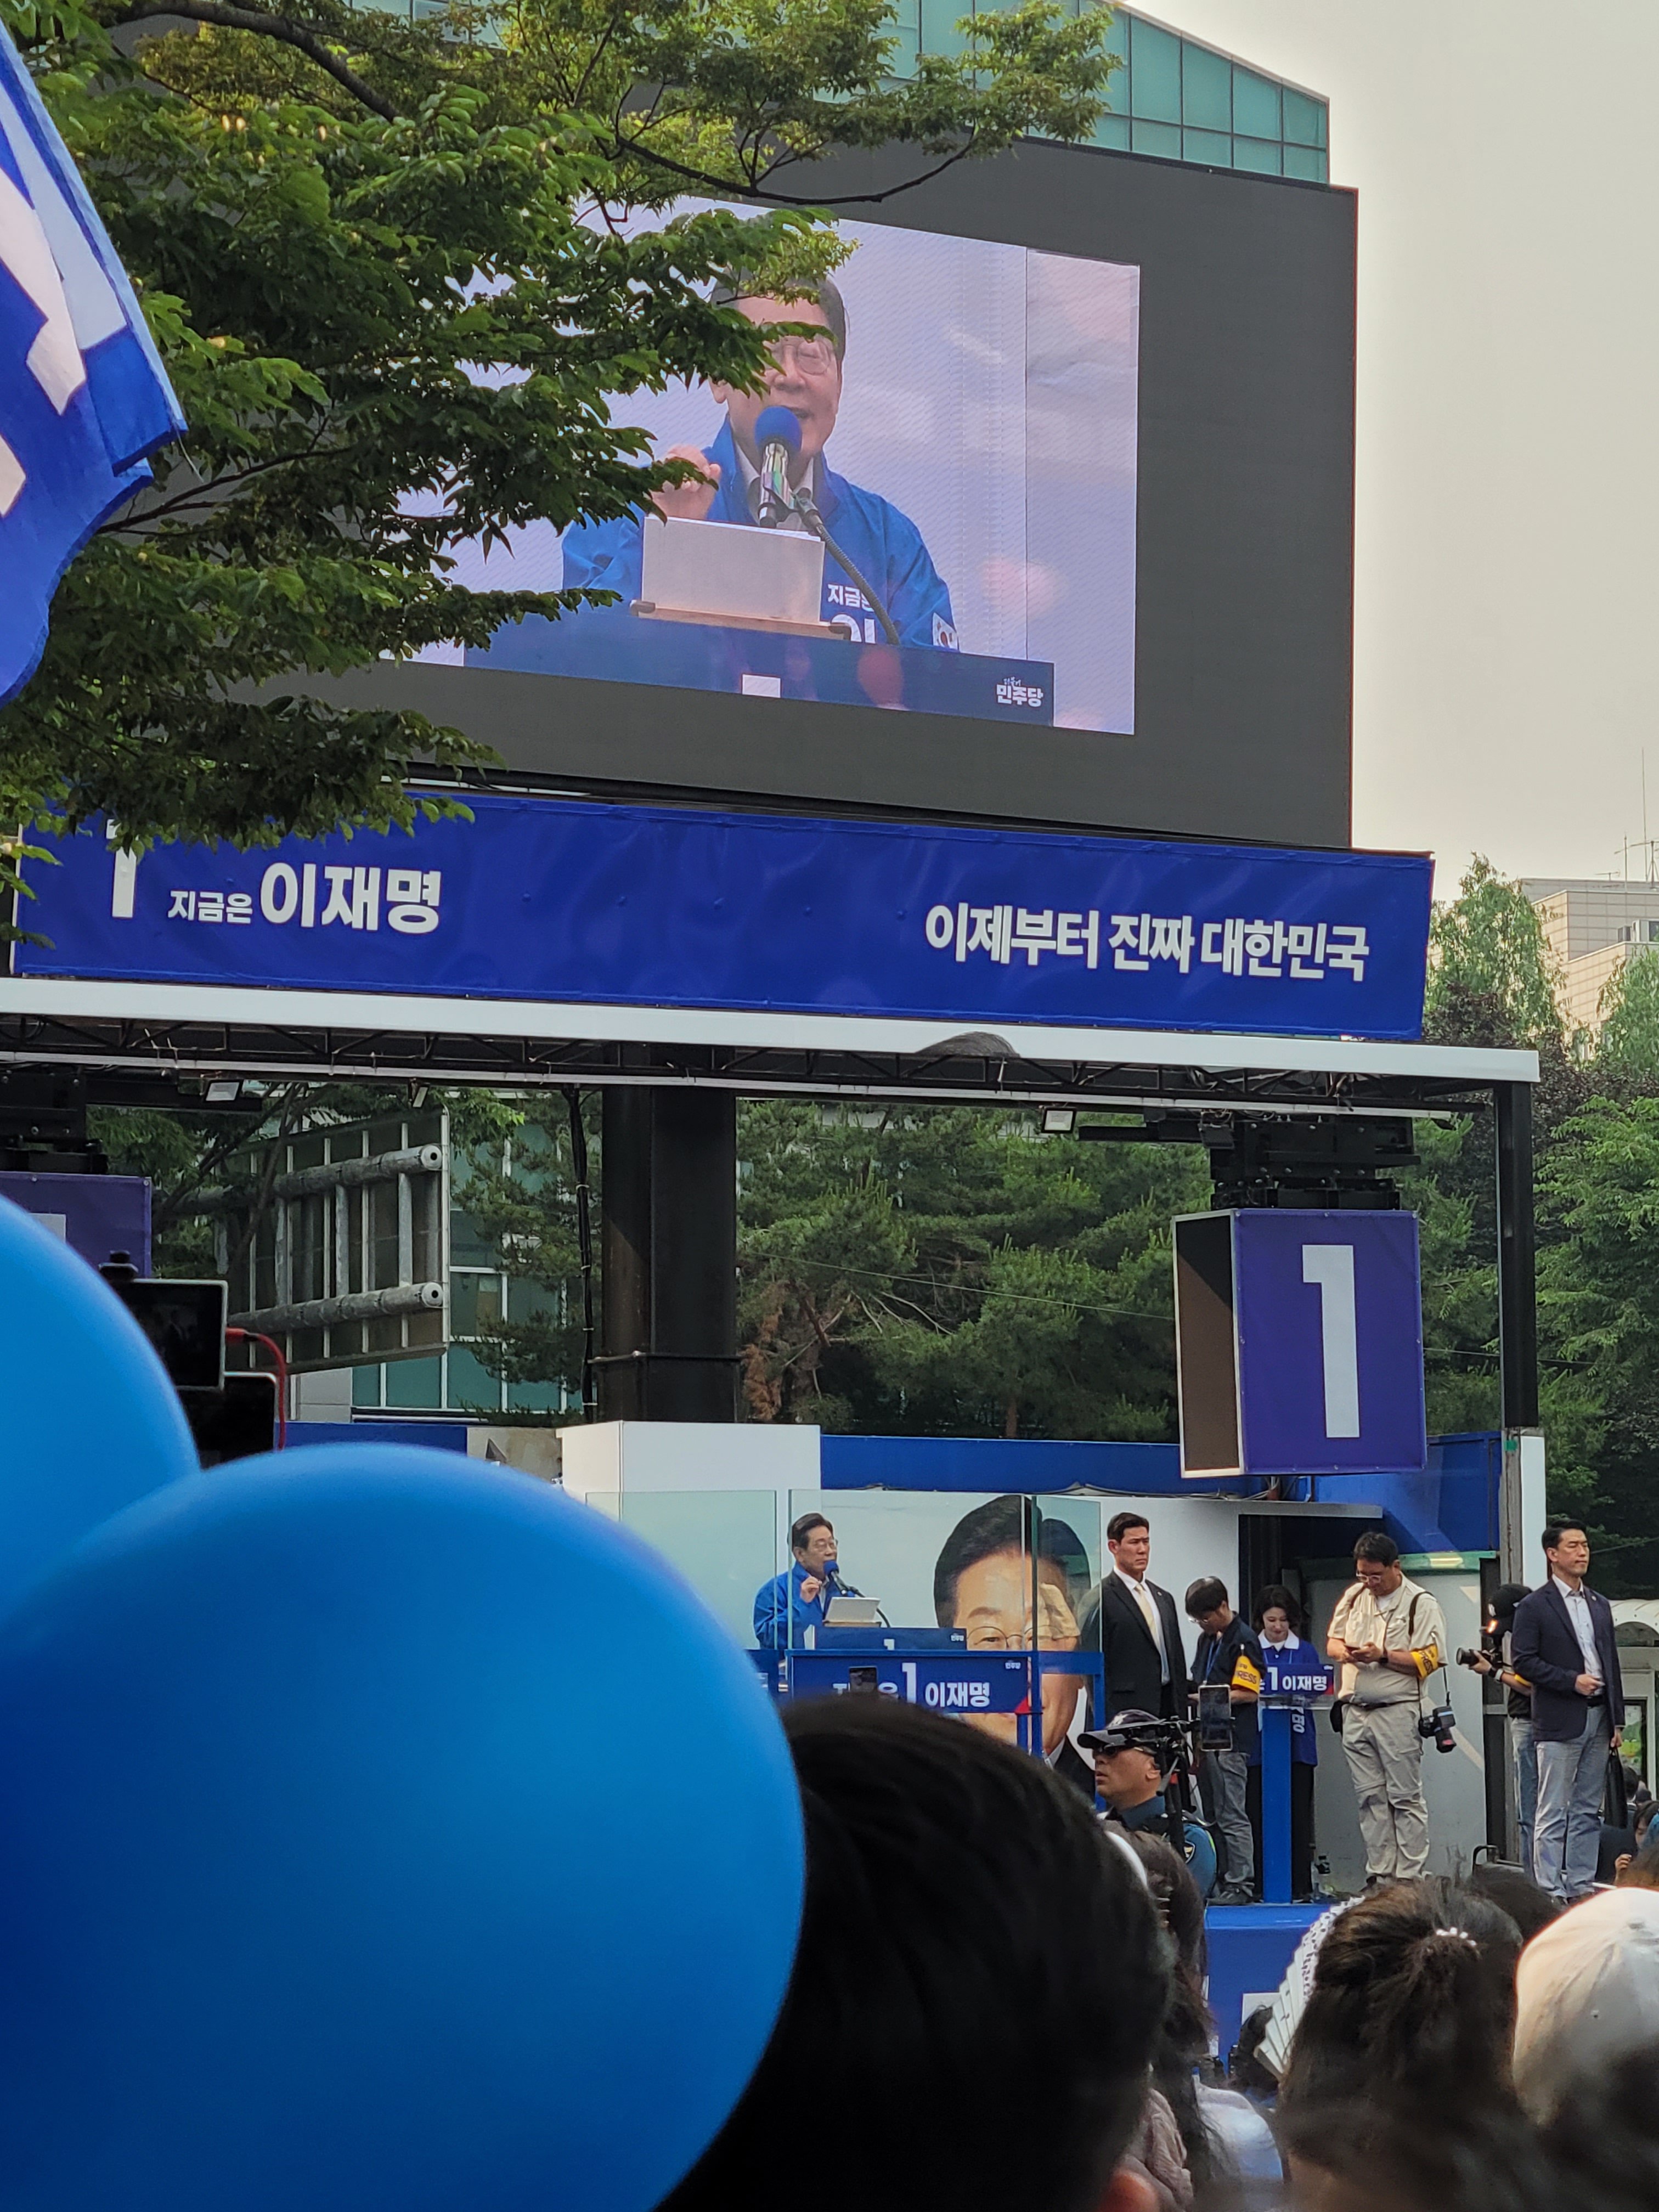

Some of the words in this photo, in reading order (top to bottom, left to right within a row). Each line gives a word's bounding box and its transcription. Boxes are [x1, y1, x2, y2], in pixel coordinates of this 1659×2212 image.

[996, 684, 1044, 708] 민주당
[168, 890, 253, 924] 지금은
[260, 862, 442, 934] 이재명
[925, 901, 1099, 969] 이제부터
[1108, 913, 1195, 973] 진짜
[1200, 918, 1370, 982] 대한민국
[1302, 1245, 1360, 1438] 1
[902, 1662, 917, 1704] 1
[924, 1681, 990, 1708] 이재명
[1267, 1666, 1278, 1691] 1
[1282, 1675, 1327, 1691] 이재명
